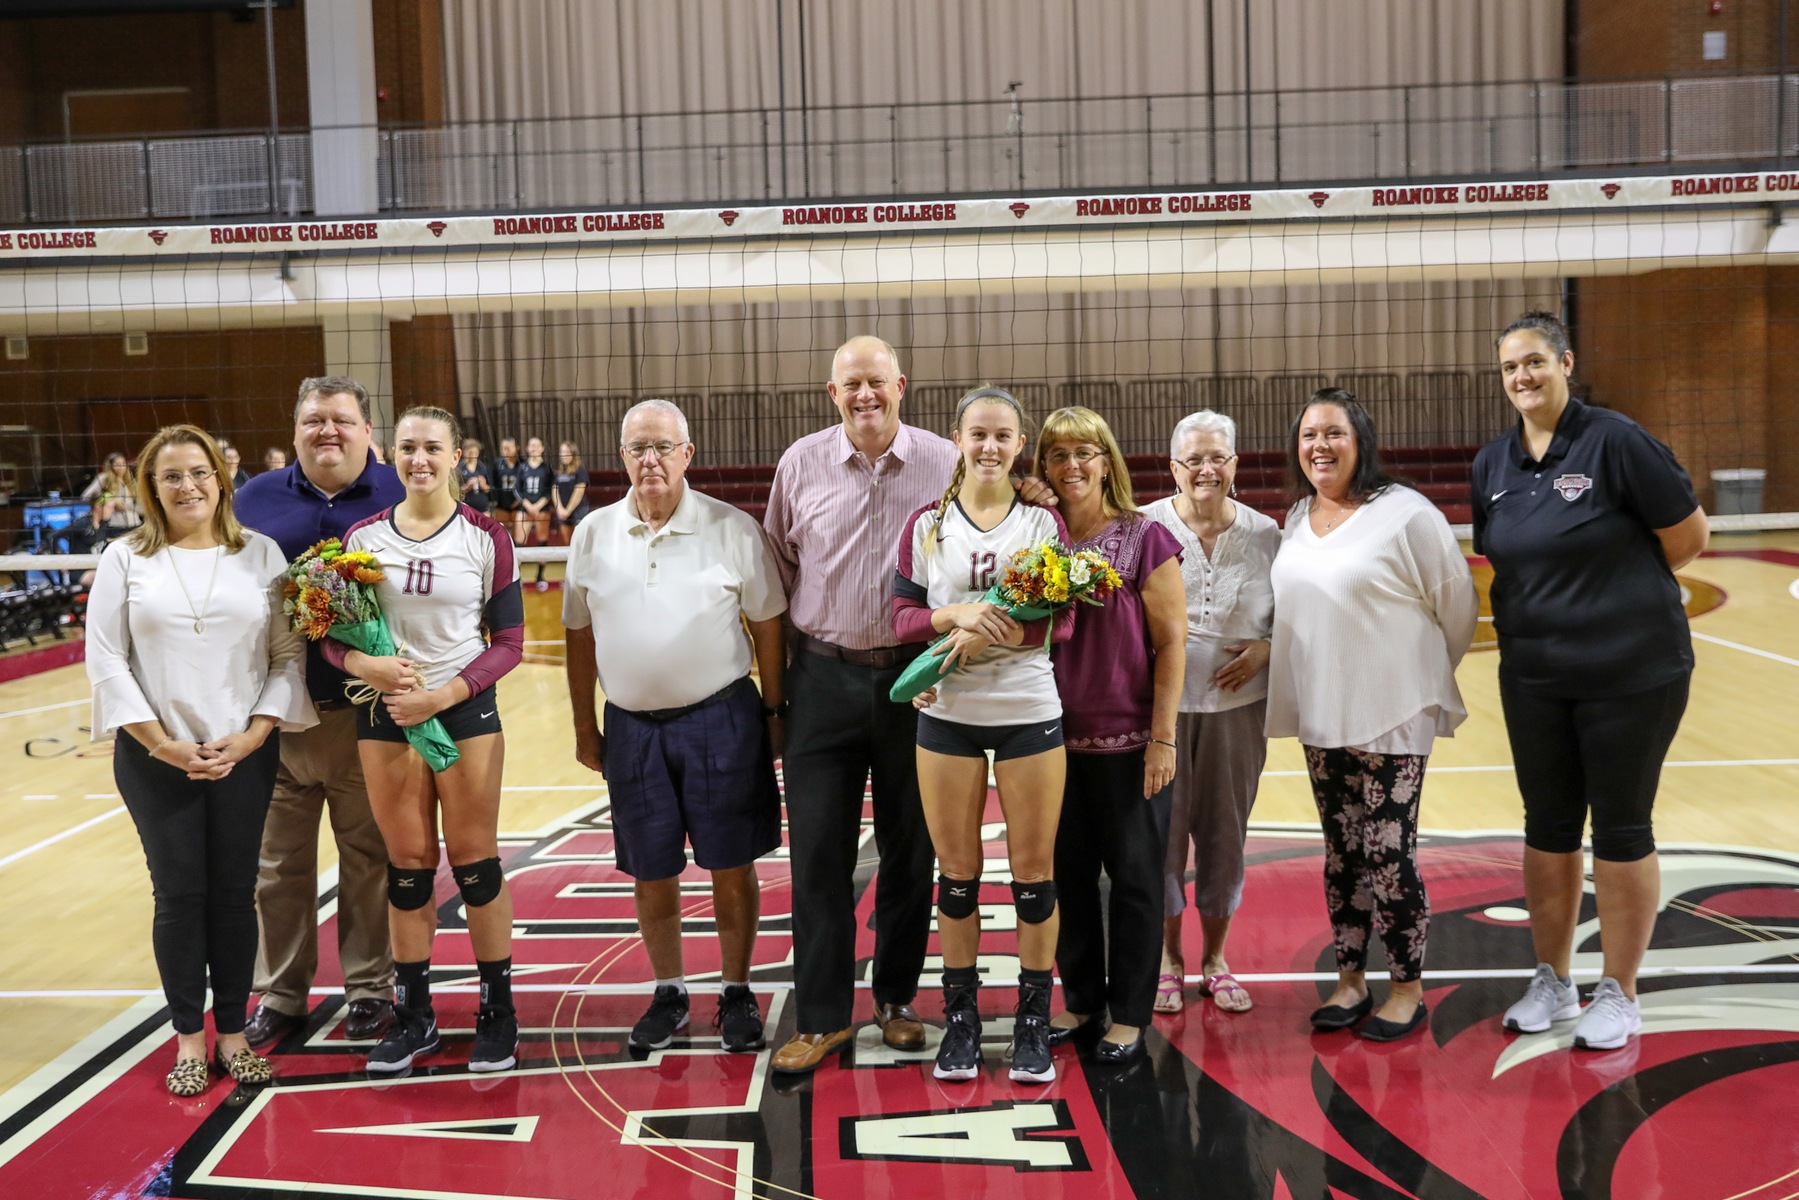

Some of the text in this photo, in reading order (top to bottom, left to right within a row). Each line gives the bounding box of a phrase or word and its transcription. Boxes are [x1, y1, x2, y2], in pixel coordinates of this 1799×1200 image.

[1373, 183, 1549, 206] ROANOKE COLLEGE
[1671, 175, 1759, 196] ROANOKE
[783, 203, 956, 225] ROANOKE COLLEGE
[1077, 193, 1251, 216] ROANOKE COLLEGE
[211, 223, 377, 244] ROANOKE COLLEGE
[494, 213, 665, 235] ROANOKE COLLEGE
[0, 231, 97, 249] E COLLEGE
[501, 475, 518, 491] 12
[526, 476, 540, 494] 11
[402, 558, 434, 597] 10
[969, 551, 997, 592] 12
